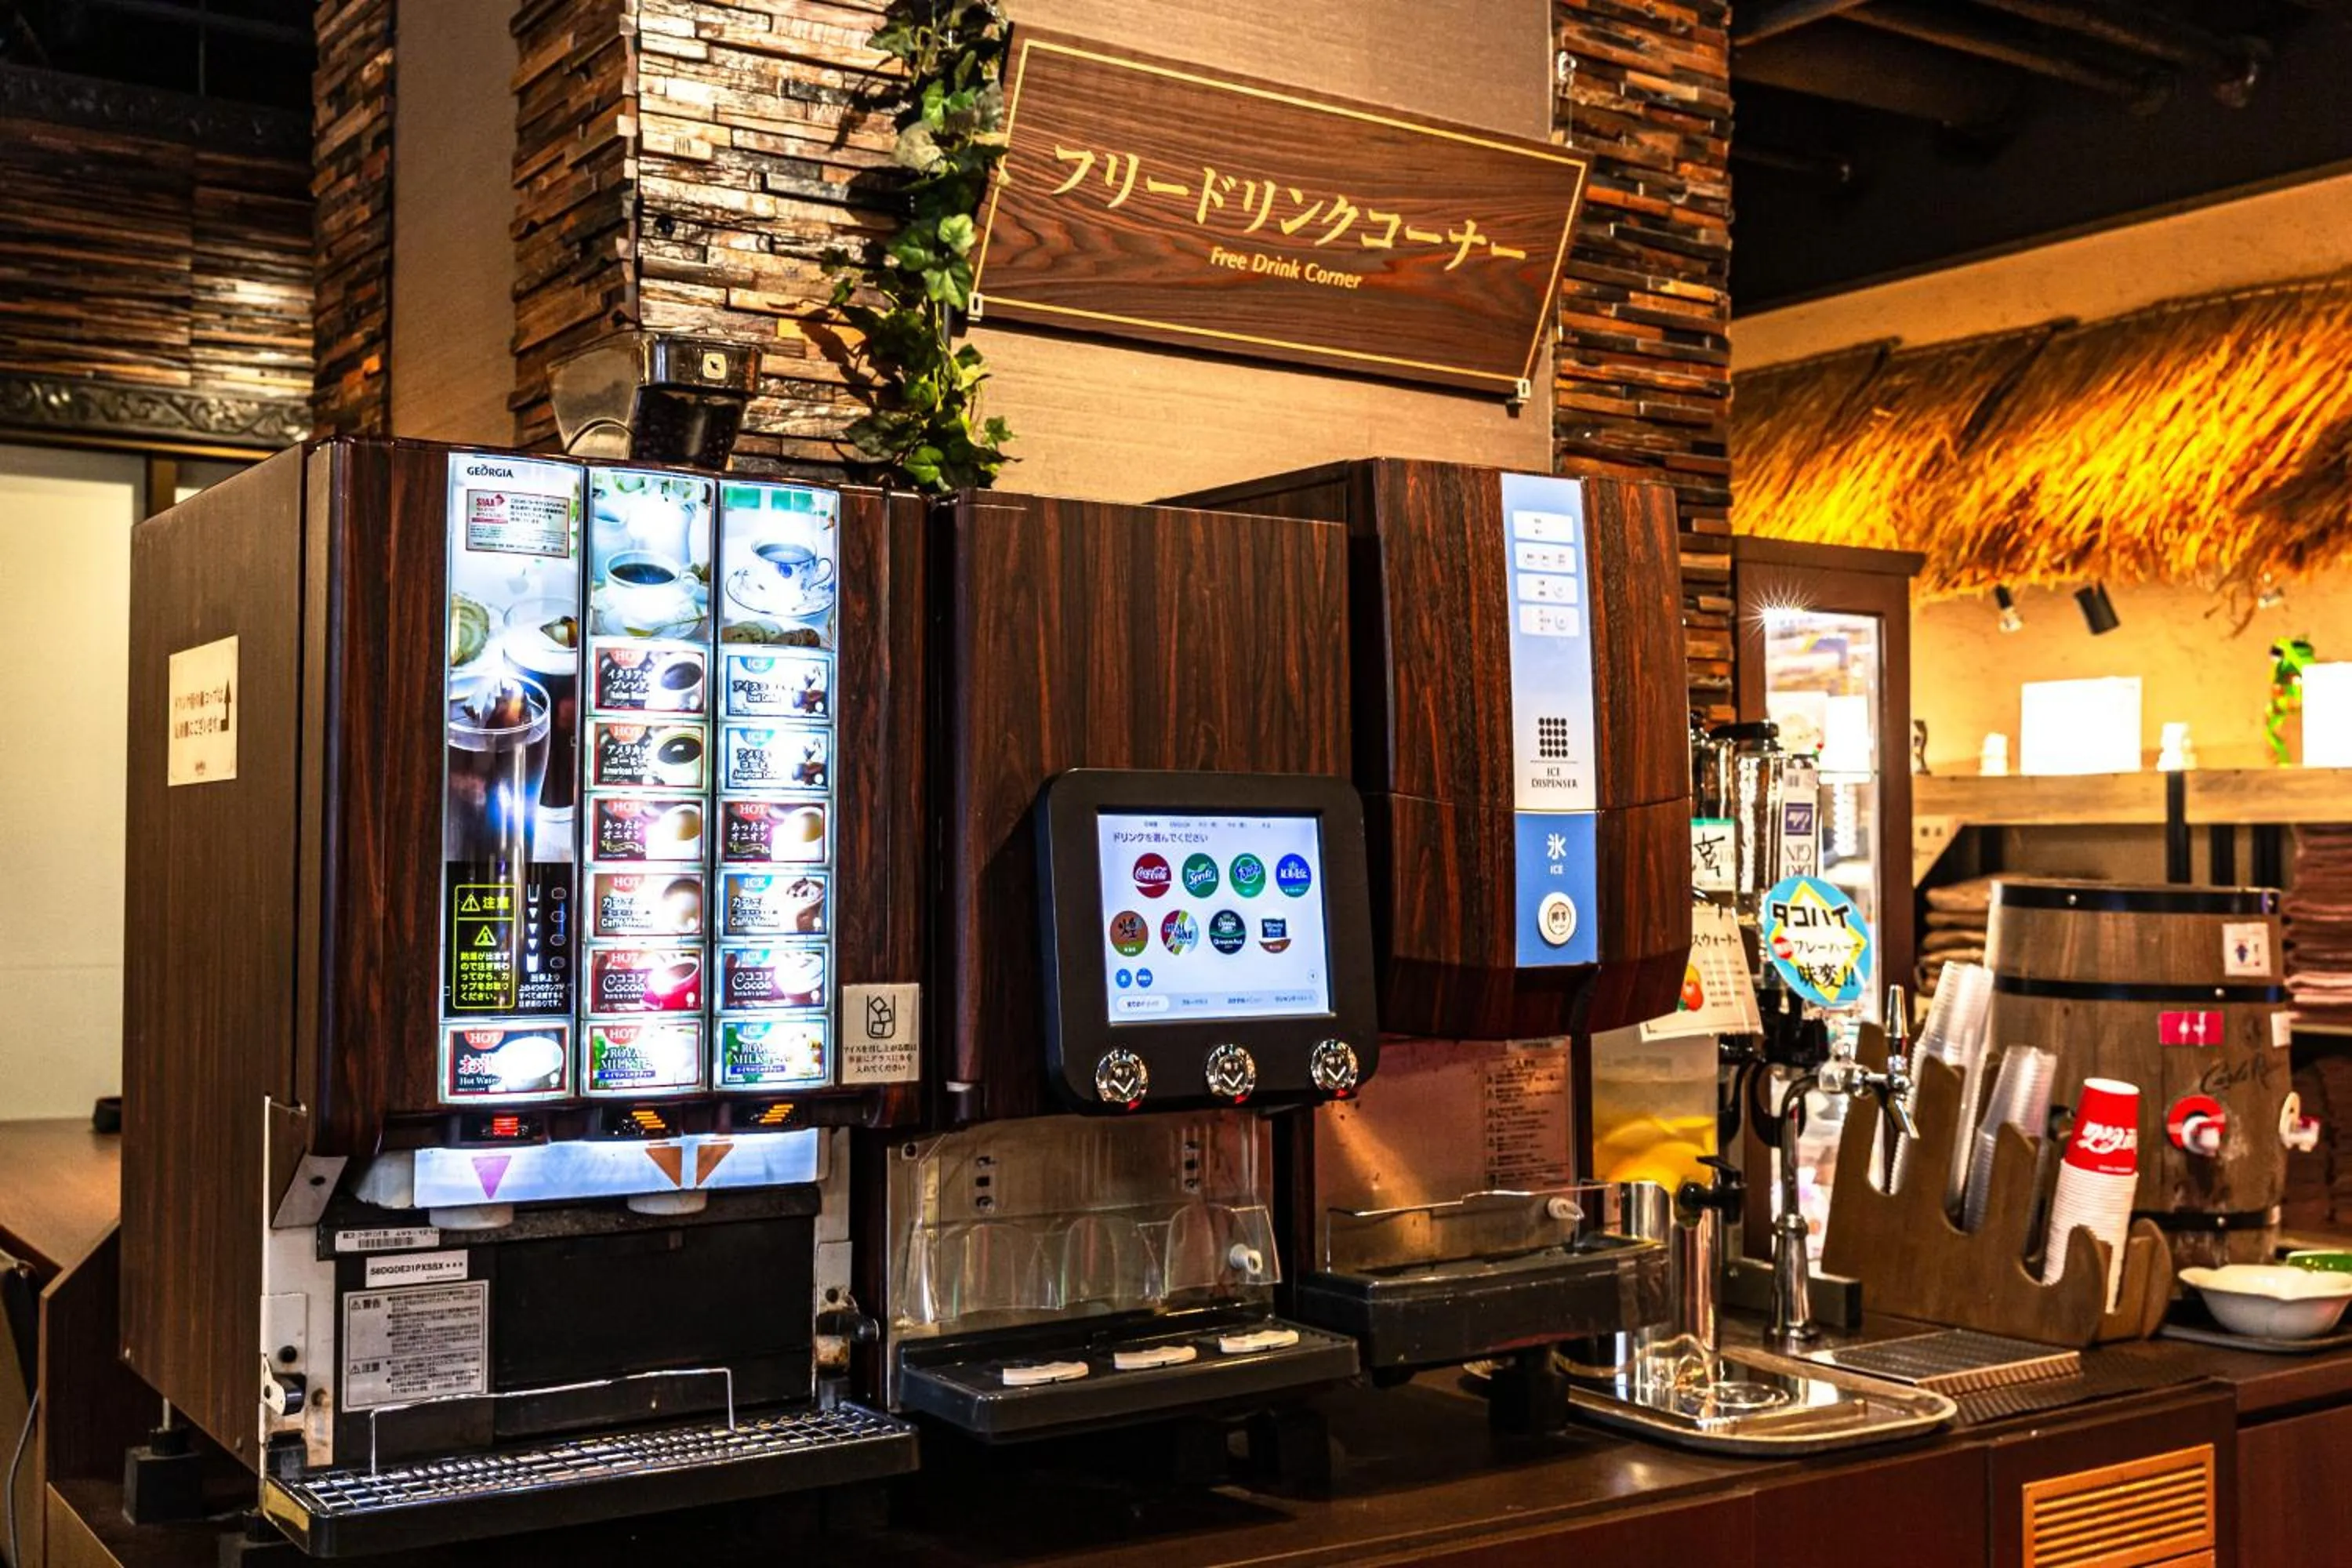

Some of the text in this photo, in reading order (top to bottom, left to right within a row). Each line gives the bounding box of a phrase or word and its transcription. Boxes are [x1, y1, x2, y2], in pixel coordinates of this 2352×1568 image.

[1053, 143, 1526, 271] フリードリンクコーナー
[1210, 246, 1362, 290] Free Drink Corner
[466, 464, 514, 478] GEORGIA
[740, 804, 767, 814] HOT
[1113, 832, 1208, 843] ドリンクを選んでください
[1546, 832, 1567, 860] 氷
[1550, 865, 1563, 875] ICE
[614, 876, 641, 887] HOT
[744, 877, 766, 888] ICE
[1773, 903, 1850, 929] タコハイ
[470, 1033, 499, 1044] HOT
[609, 1028, 636, 1039] HOT
